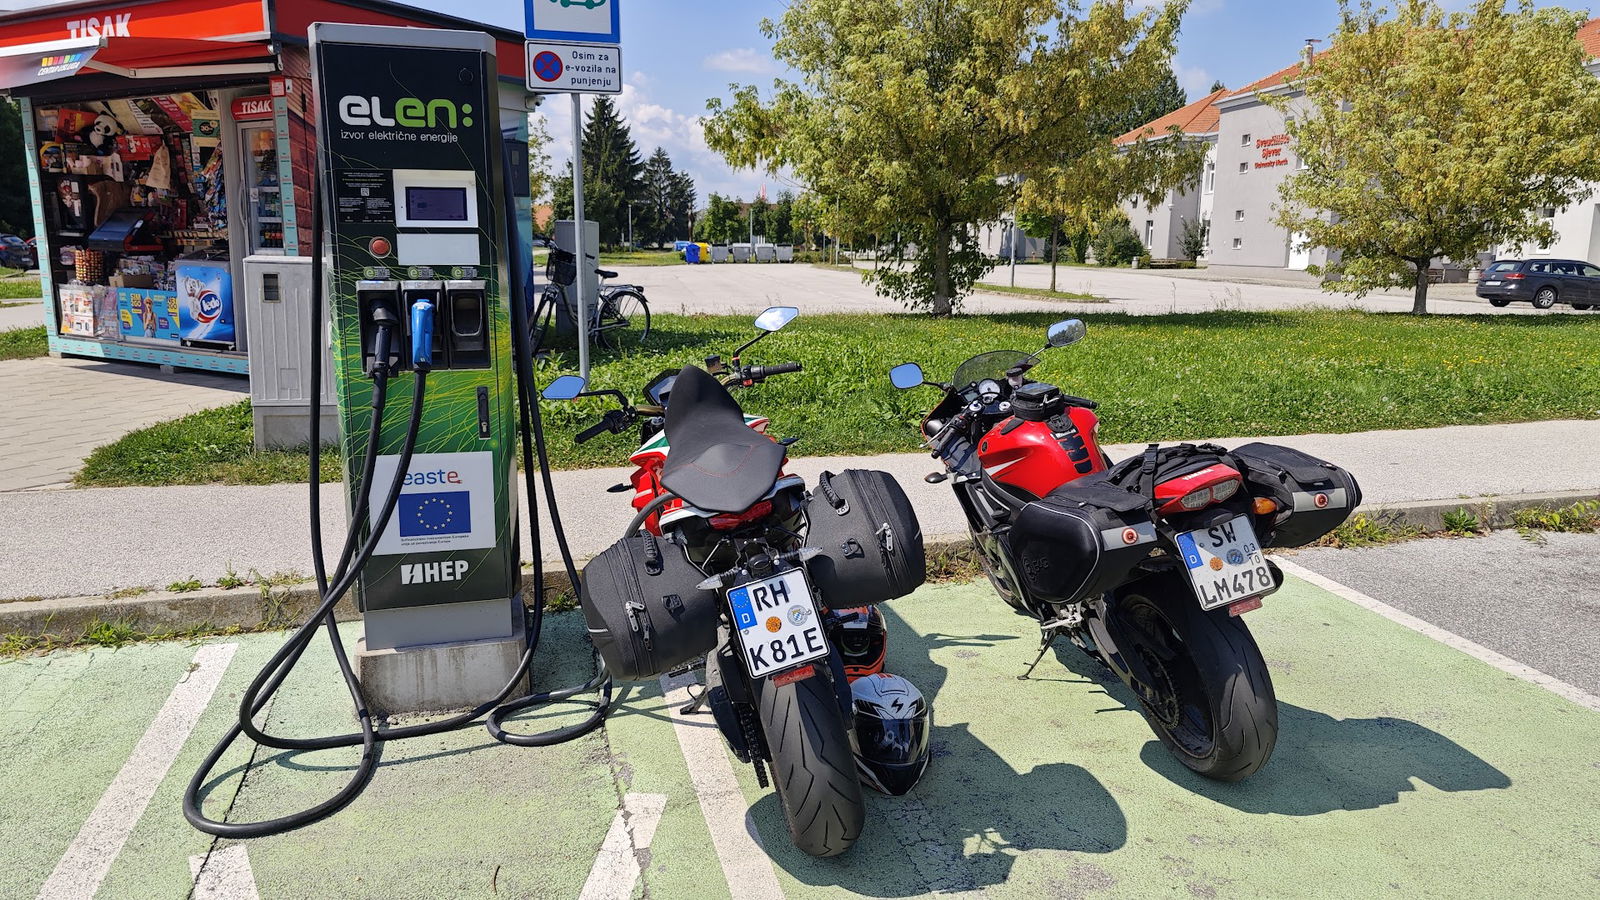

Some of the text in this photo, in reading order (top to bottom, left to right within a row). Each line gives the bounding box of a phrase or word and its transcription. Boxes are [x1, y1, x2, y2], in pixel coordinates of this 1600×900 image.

[67, 13, 131, 39] TISAK
[572, 50, 594, 60] Osim
[565, 64, 602, 72] e-vozila
[571, 77, 611, 87] punjenju
[241, 100, 273, 114] TISAK
[341, 129, 458, 143] izvor električne energije
[1208, 522, 1237, 547] SW
[1243, 542, 1256, 553] 03
[1189, 554, 1197, 564] D
[424, 560, 469, 583] HEP
[753, 580, 789, 612] RH
[741, 613, 751, 624] D
